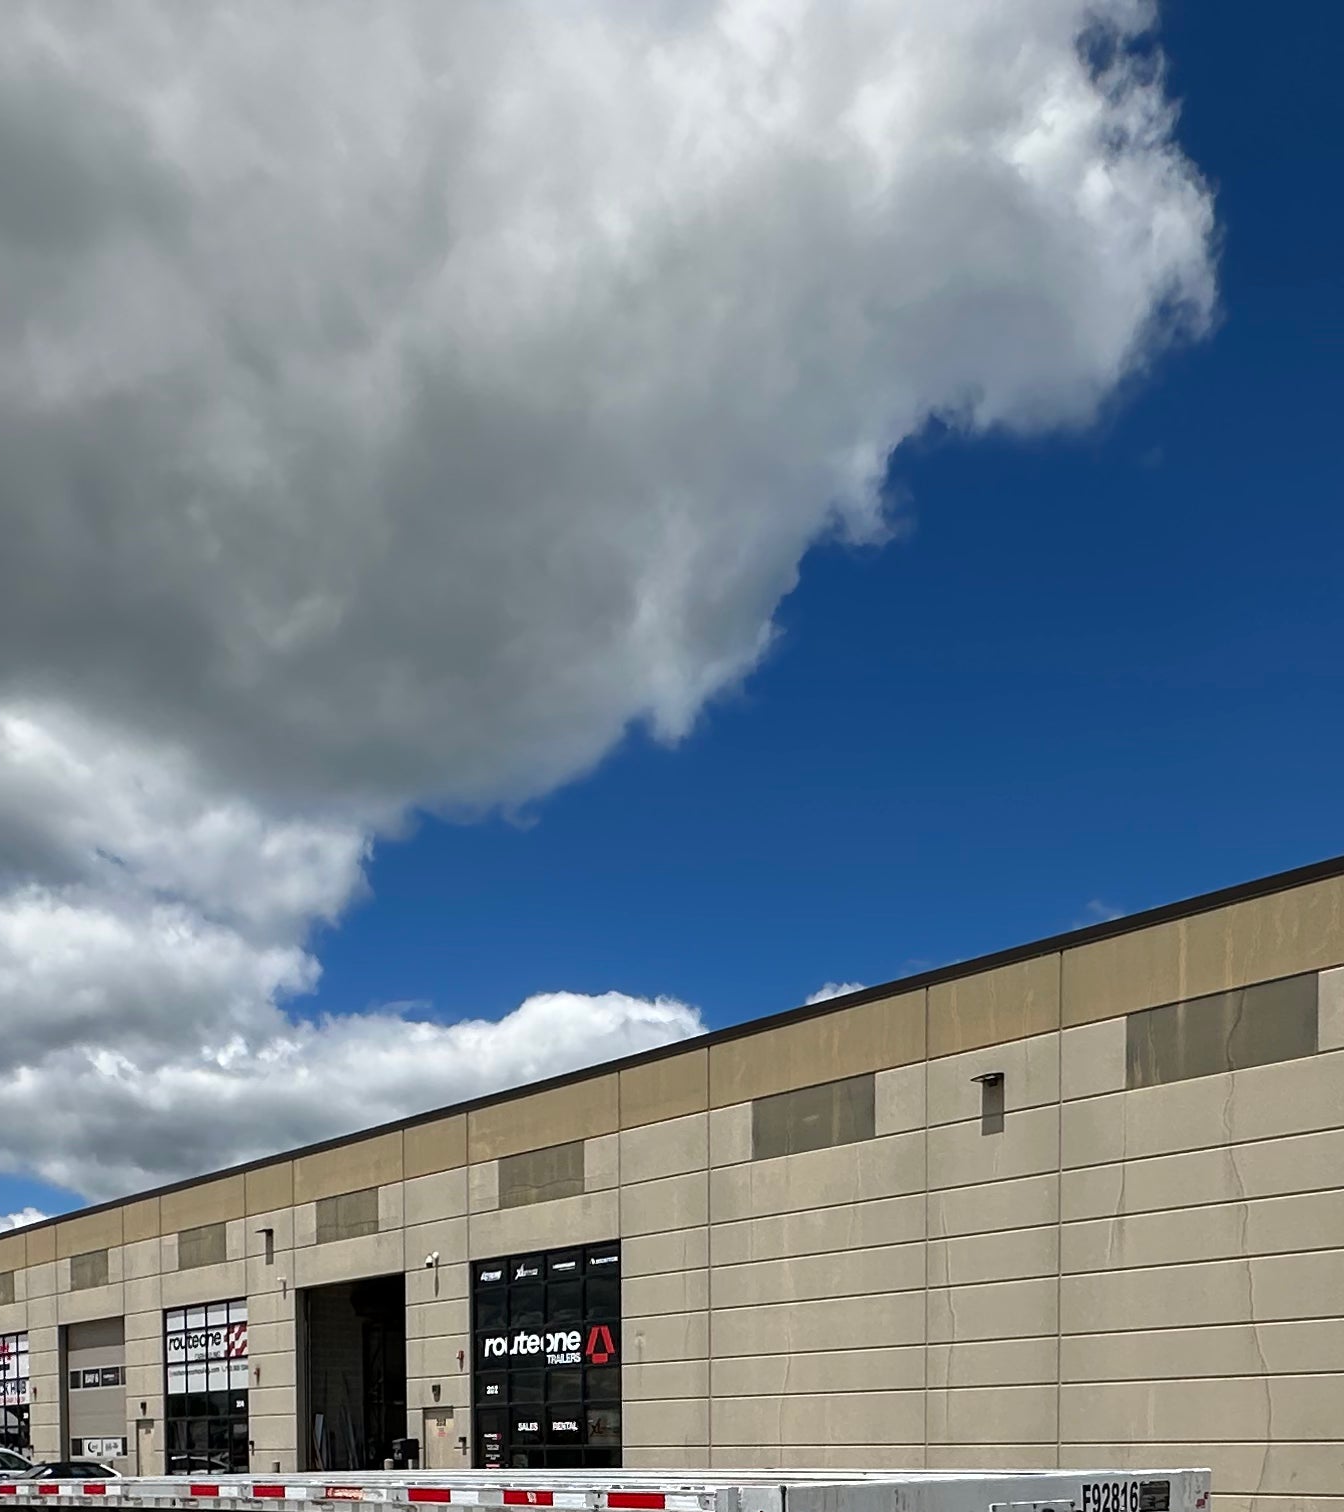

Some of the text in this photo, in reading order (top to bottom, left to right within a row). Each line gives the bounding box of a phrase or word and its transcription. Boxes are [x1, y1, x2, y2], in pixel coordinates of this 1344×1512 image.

[169, 1331, 222, 1352] routeone
[484, 1330, 582, 1358] routeone
[546, 1351, 582, 1365] TRAILERS
[517, 1422, 539, 1432] SALES
[552, 1421, 578, 1431] RENTAL
